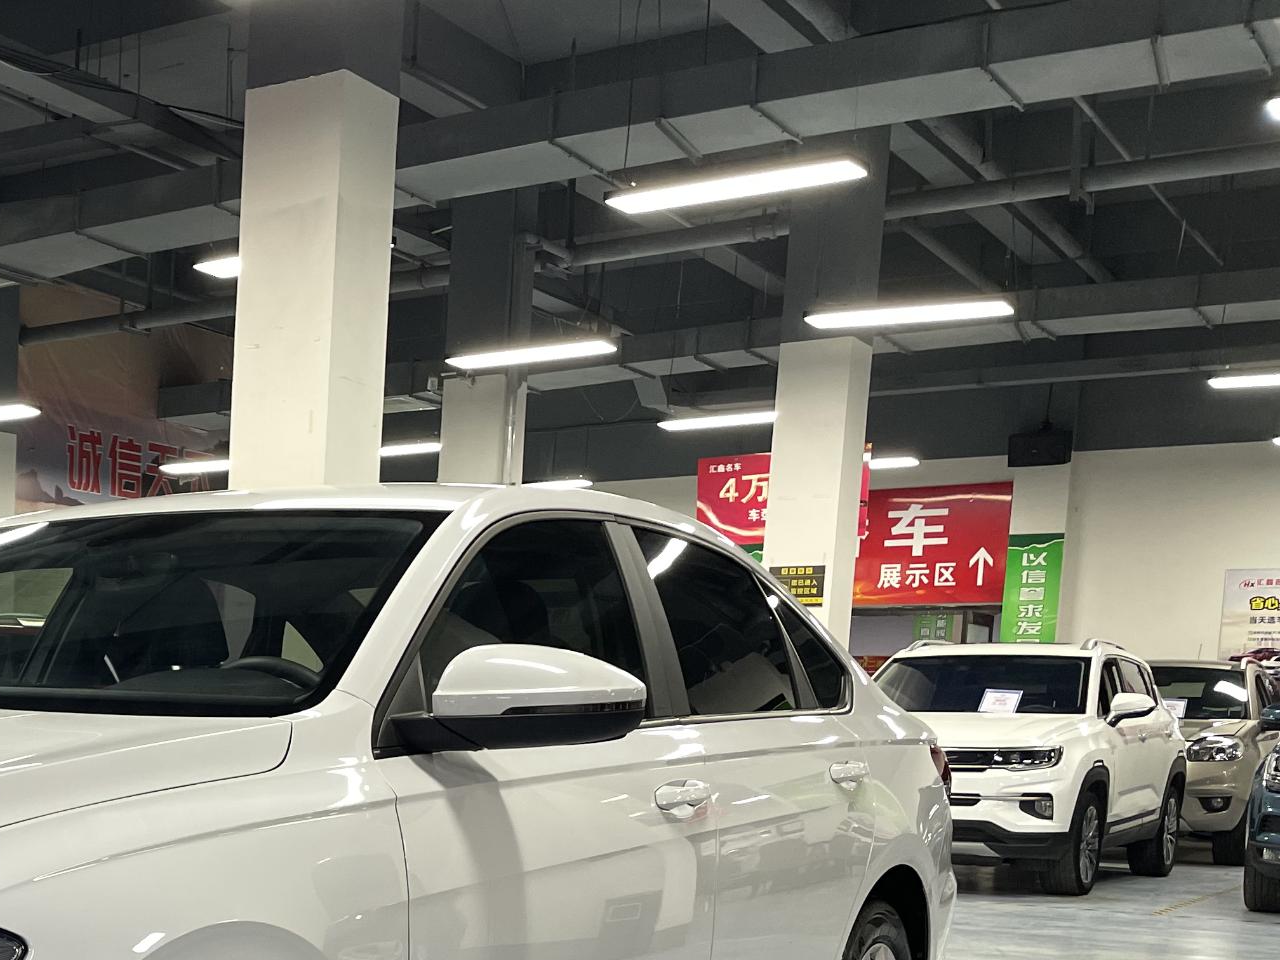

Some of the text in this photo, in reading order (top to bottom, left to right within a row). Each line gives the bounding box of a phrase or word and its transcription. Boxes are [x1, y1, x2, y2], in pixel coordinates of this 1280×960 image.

[720, 473, 771, 503] 4万
[856, 503, 949, 557] 车
[877, 562, 956, 588] 展示区
[1016, 551, 1048, 643] 以信求发
[1250, 597, 1280, 611] 省心
